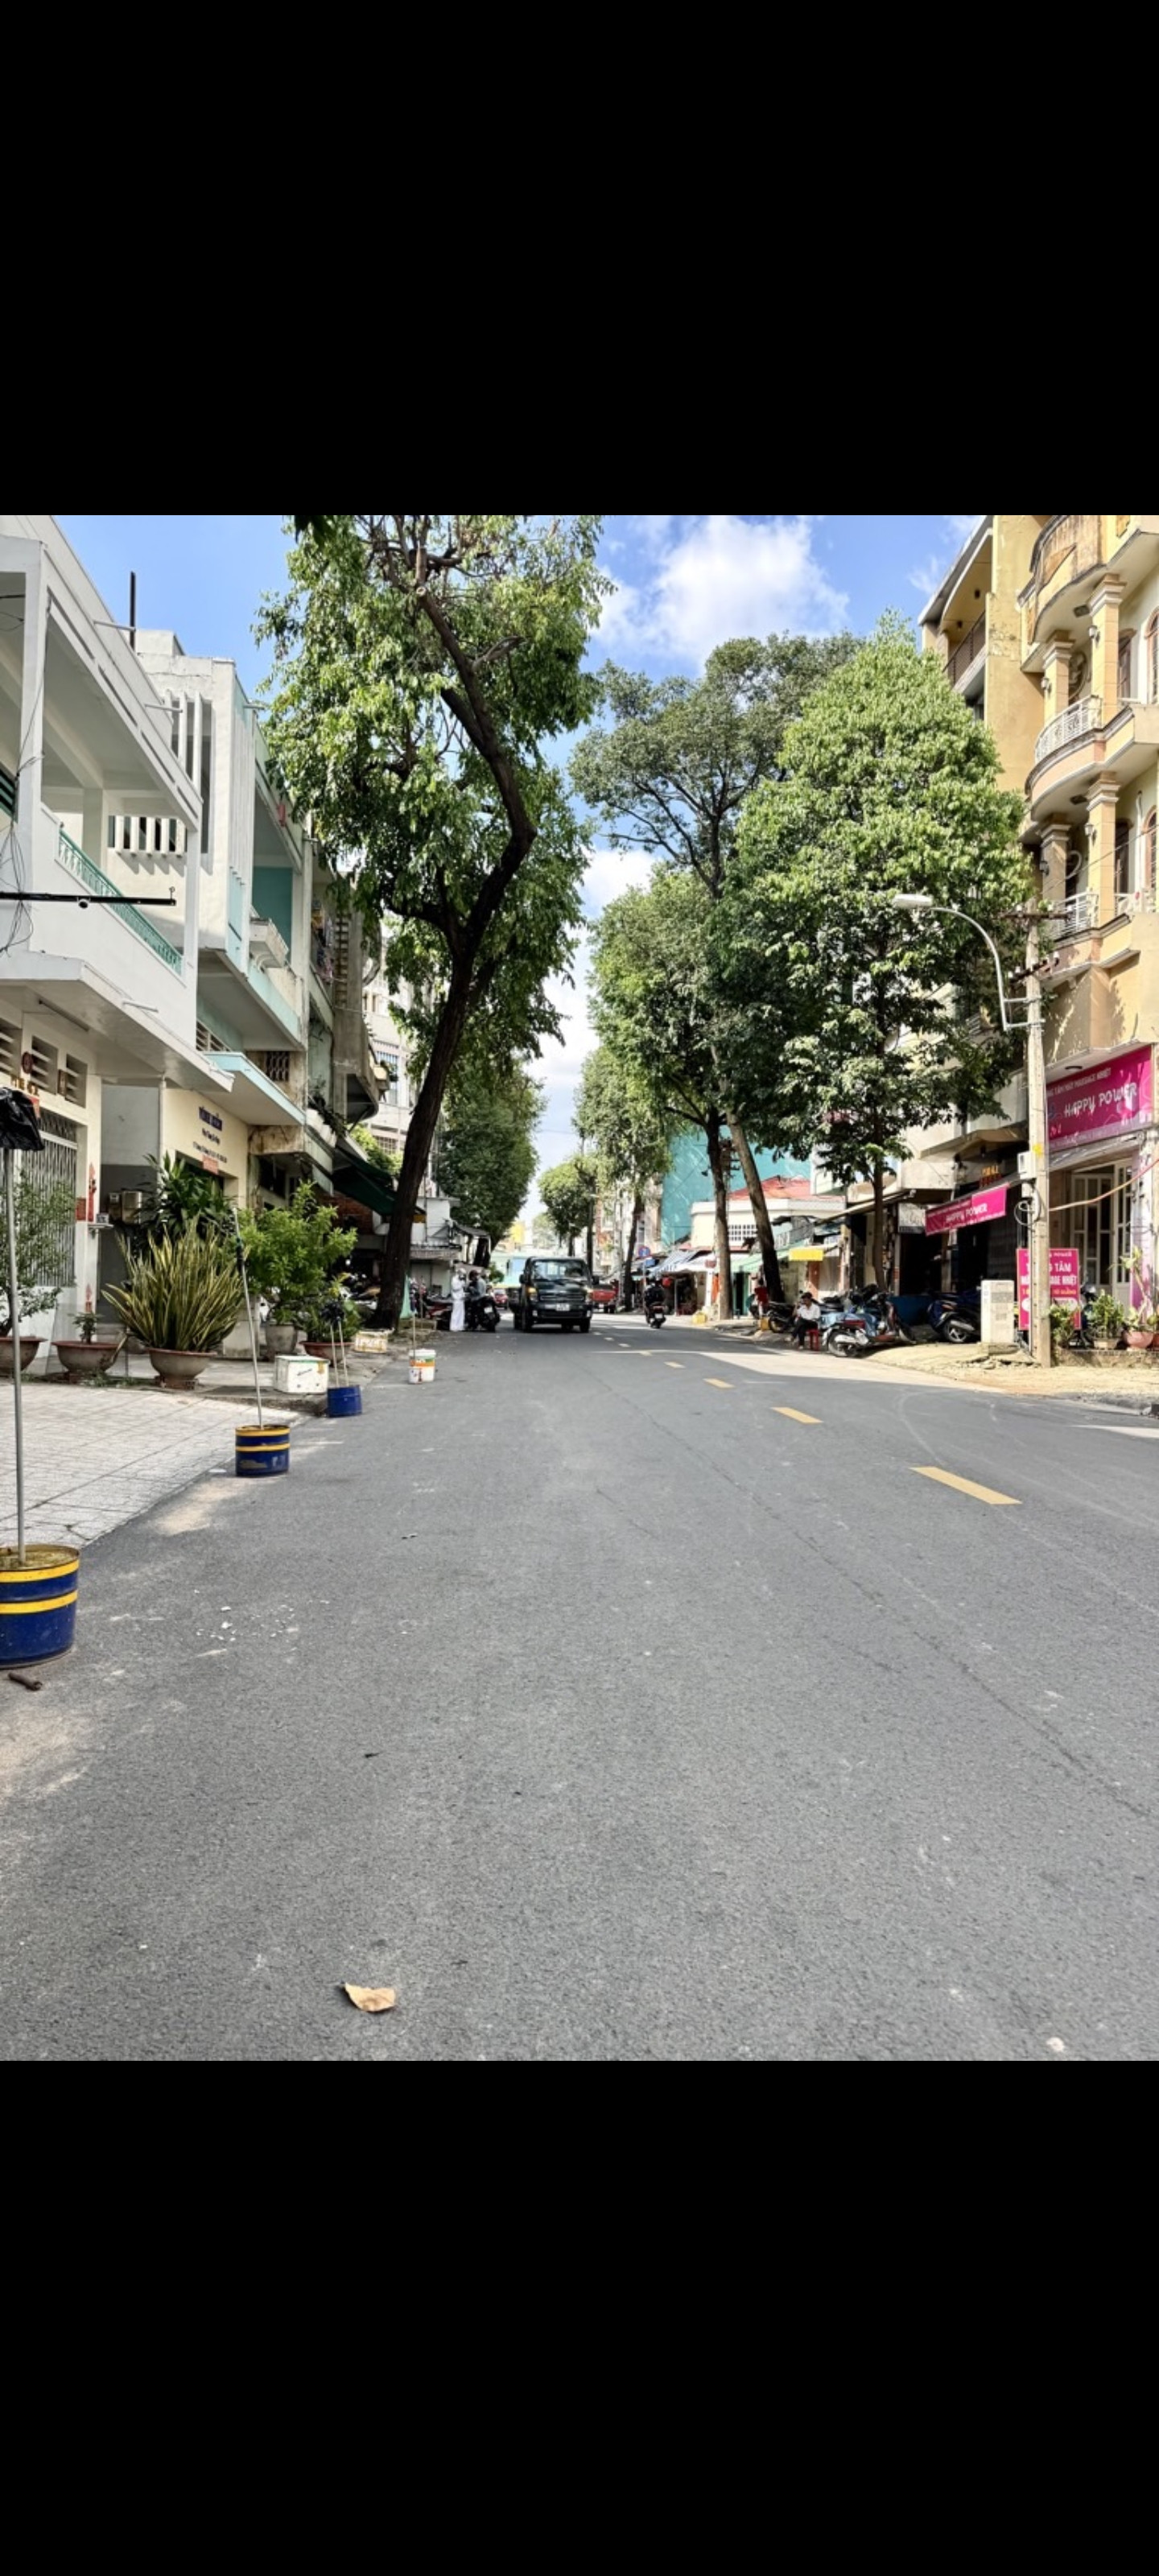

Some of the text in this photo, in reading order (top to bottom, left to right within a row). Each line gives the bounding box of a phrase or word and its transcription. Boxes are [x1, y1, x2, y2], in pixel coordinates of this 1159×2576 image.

[1064, 1082, 1136, 1117] HAPPY POWER
[1055, 1260, 1071, 1272] TÂM
